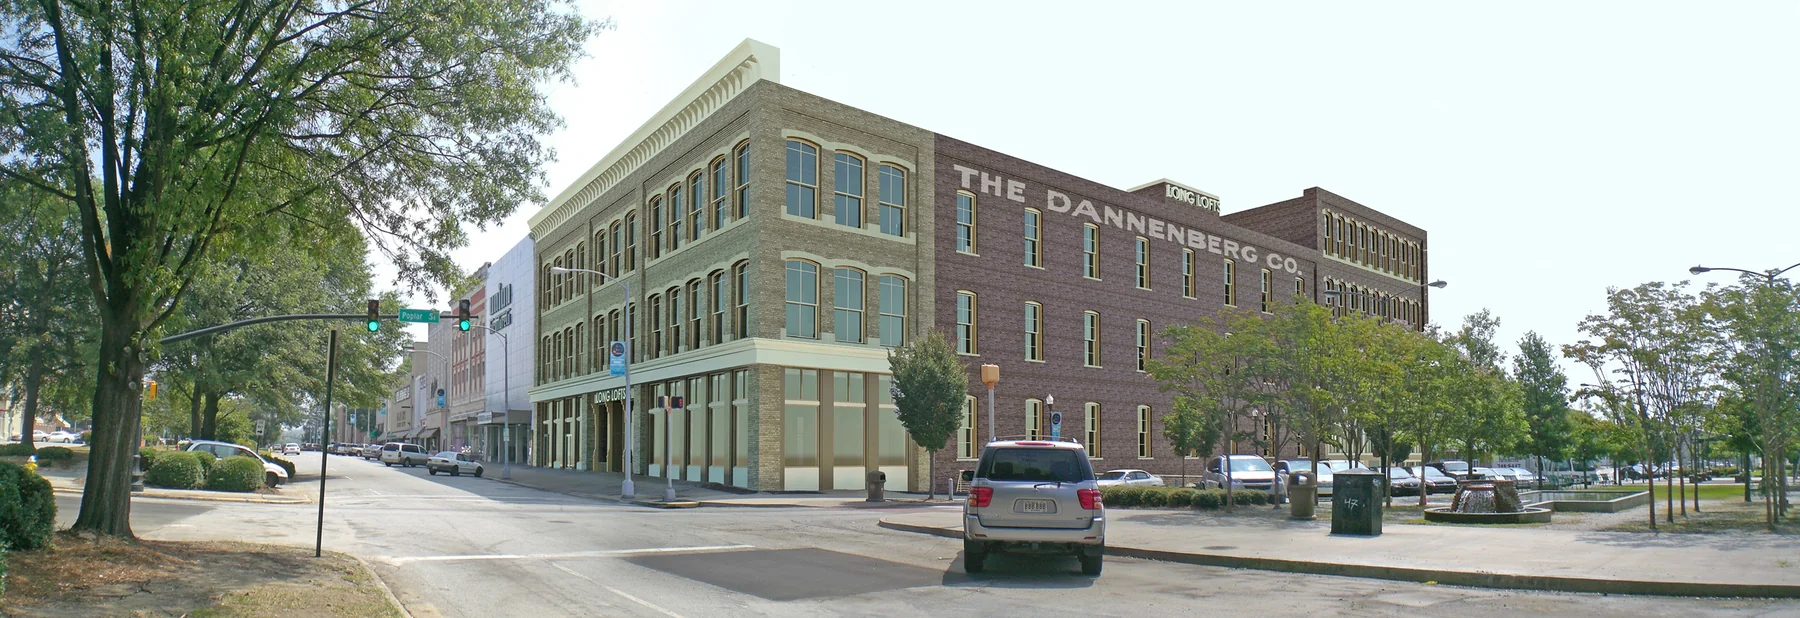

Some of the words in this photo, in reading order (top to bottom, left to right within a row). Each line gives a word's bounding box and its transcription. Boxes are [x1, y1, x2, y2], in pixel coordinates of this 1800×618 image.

[1165, 184, 1195, 205] LONG
[1195, 194, 1221, 213] LOFTS
[953, 163, 1026, 203] THE
[1047, 189, 1258, 264] DANNENBERG
[1266, 252, 1303, 276] CO.
[401, 311, 423, 321] Poplar
[428, 312, 437, 321] St
[594, 390, 611, 404] LONG
[611, 387, 626, 401] LOFTS
[1344, 497, 1359, 510] 47
